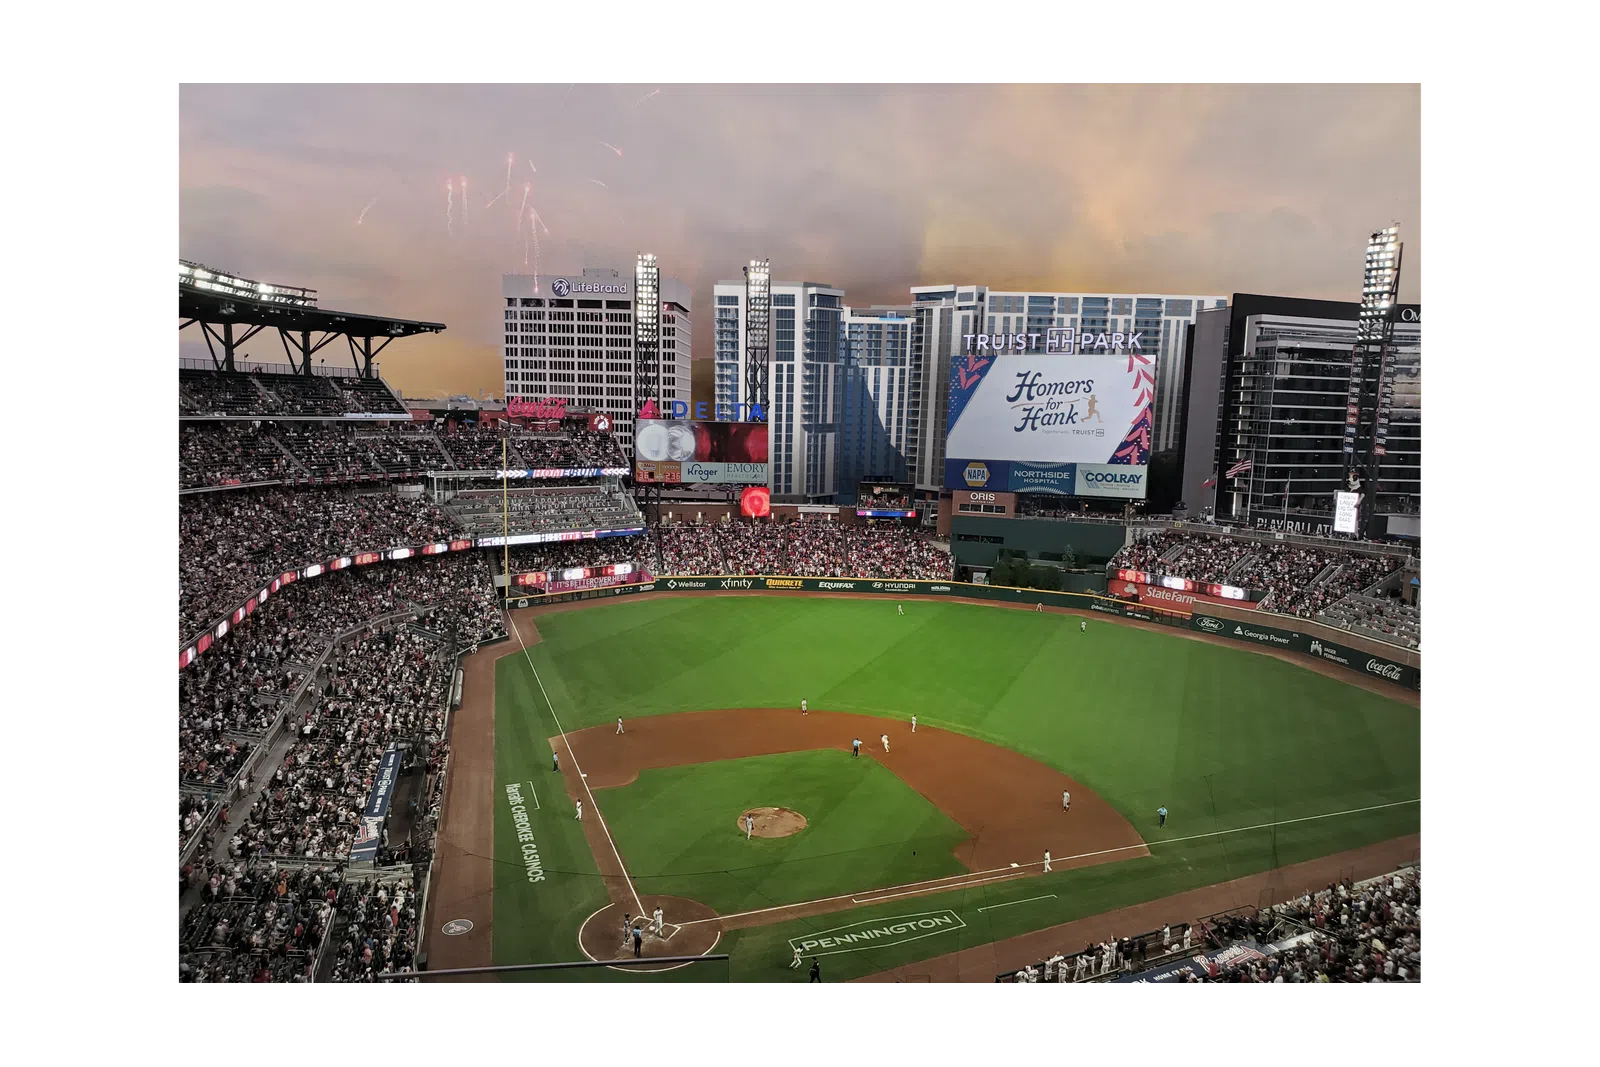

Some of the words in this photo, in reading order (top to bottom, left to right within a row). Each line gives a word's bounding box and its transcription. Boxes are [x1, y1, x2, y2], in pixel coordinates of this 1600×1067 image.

[572, 281, 627, 295] LifeBrand
[963, 333, 1041, 350] TRUIST
[1081, 332, 1143, 350] PARK
[1006, 370, 1094, 403] Homers
[672, 400, 765, 421] DELTA
[1045, 397, 1063, 411] for
[1014, 404, 1079, 432] Hank
[688, 463, 718, 481] Kroger
[727, 463, 766, 473] EMORY
[967, 469, 986, 480] NAPA
[1014, 470, 1070, 479] NORTHSIDE
[1085, 472, 1143, 484] COOLRAY
[970, 492, 995, 501] ORIS
[1256, 518, 1283, 530] PLAY
[570, 577, 594, 588] BETTER
[594, 576, 612, 584] OVER
[612, 574, 628, 582] HERE
[720, 578, 753, 589] xfinity
[1200, 619, 1219, 629] Ford
[1244, 630, 1268, 640] Georgia
[1270, 634, 1290, 644] Power
[511, 805, 534, 842] CHEROKEE
[521, 843, 546, 882] CASINOS
[800, 915, 953, 951] PENNINGTON
[1152, 972, 1172, 981] HOME
